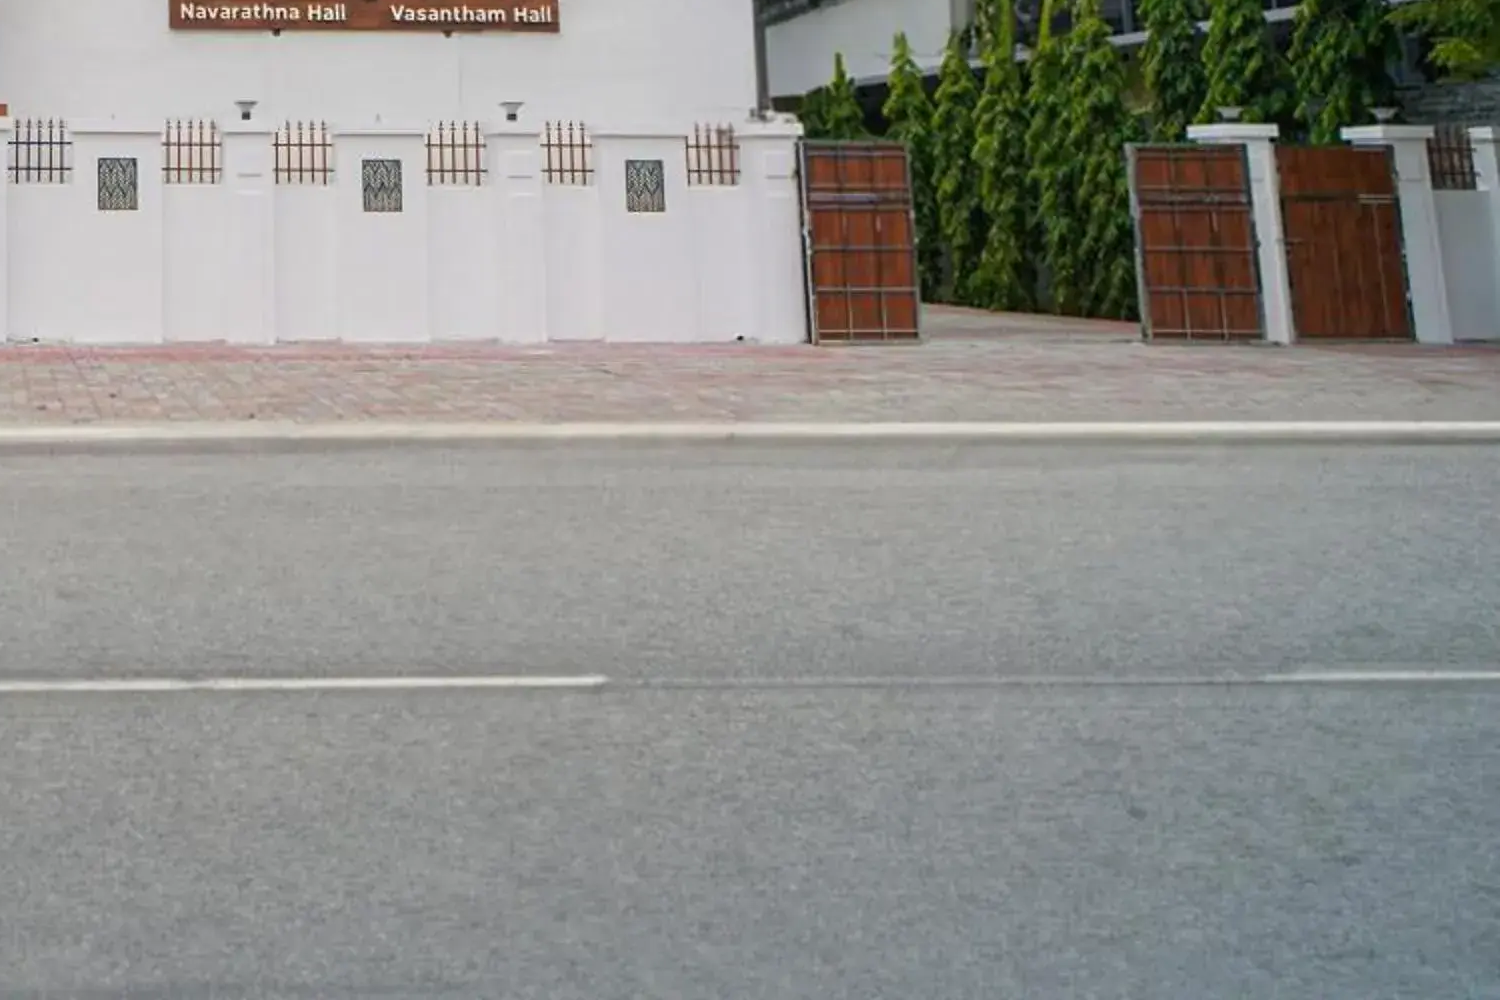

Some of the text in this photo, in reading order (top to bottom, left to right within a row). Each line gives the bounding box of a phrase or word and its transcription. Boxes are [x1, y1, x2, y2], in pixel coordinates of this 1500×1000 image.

[180, 3, 347, 22] Navarathna Hall
[390, 4, 553, 24] Vasantham Hall
